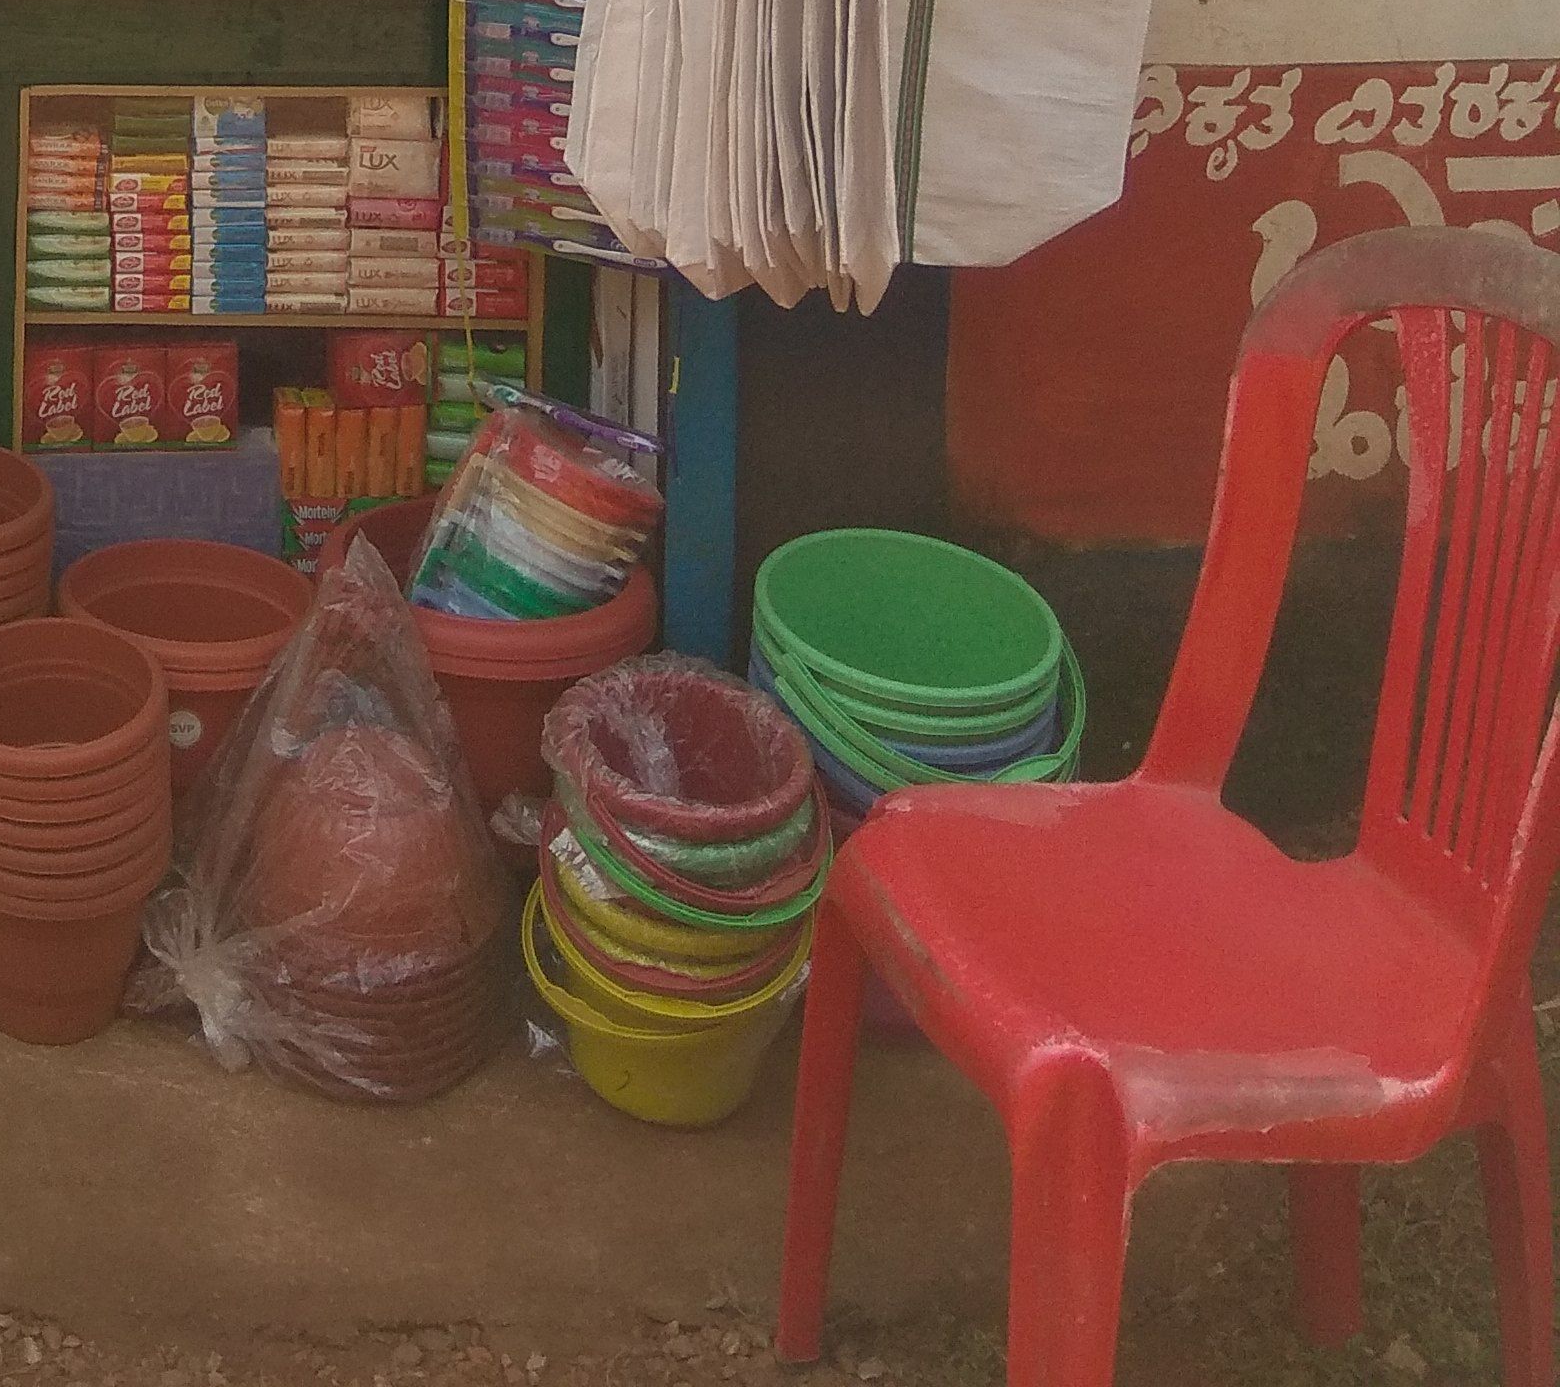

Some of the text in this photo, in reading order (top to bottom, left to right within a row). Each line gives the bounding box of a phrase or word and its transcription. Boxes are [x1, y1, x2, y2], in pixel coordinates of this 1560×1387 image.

[359, 145, 400, 171] LUX
[355, 211, 382, 223] LUX
[358, 268, 382, 278] LUX
[355, 297, 380, 307] LUX
[370, 353, 387, 388] Red
[381, 350, 402, 390] Label
[42, 382, 76, 401] Red
[115, 383, 150, 401] Red
[187, 382, 222, 401] Red
[39, 397, 78, 418] Label
[111, 397, 151, 418] Label
[183, 396, 223, 417] Label
[297, 504, 336, 519] Mortein
[304, 531, 328, 546] Mort
